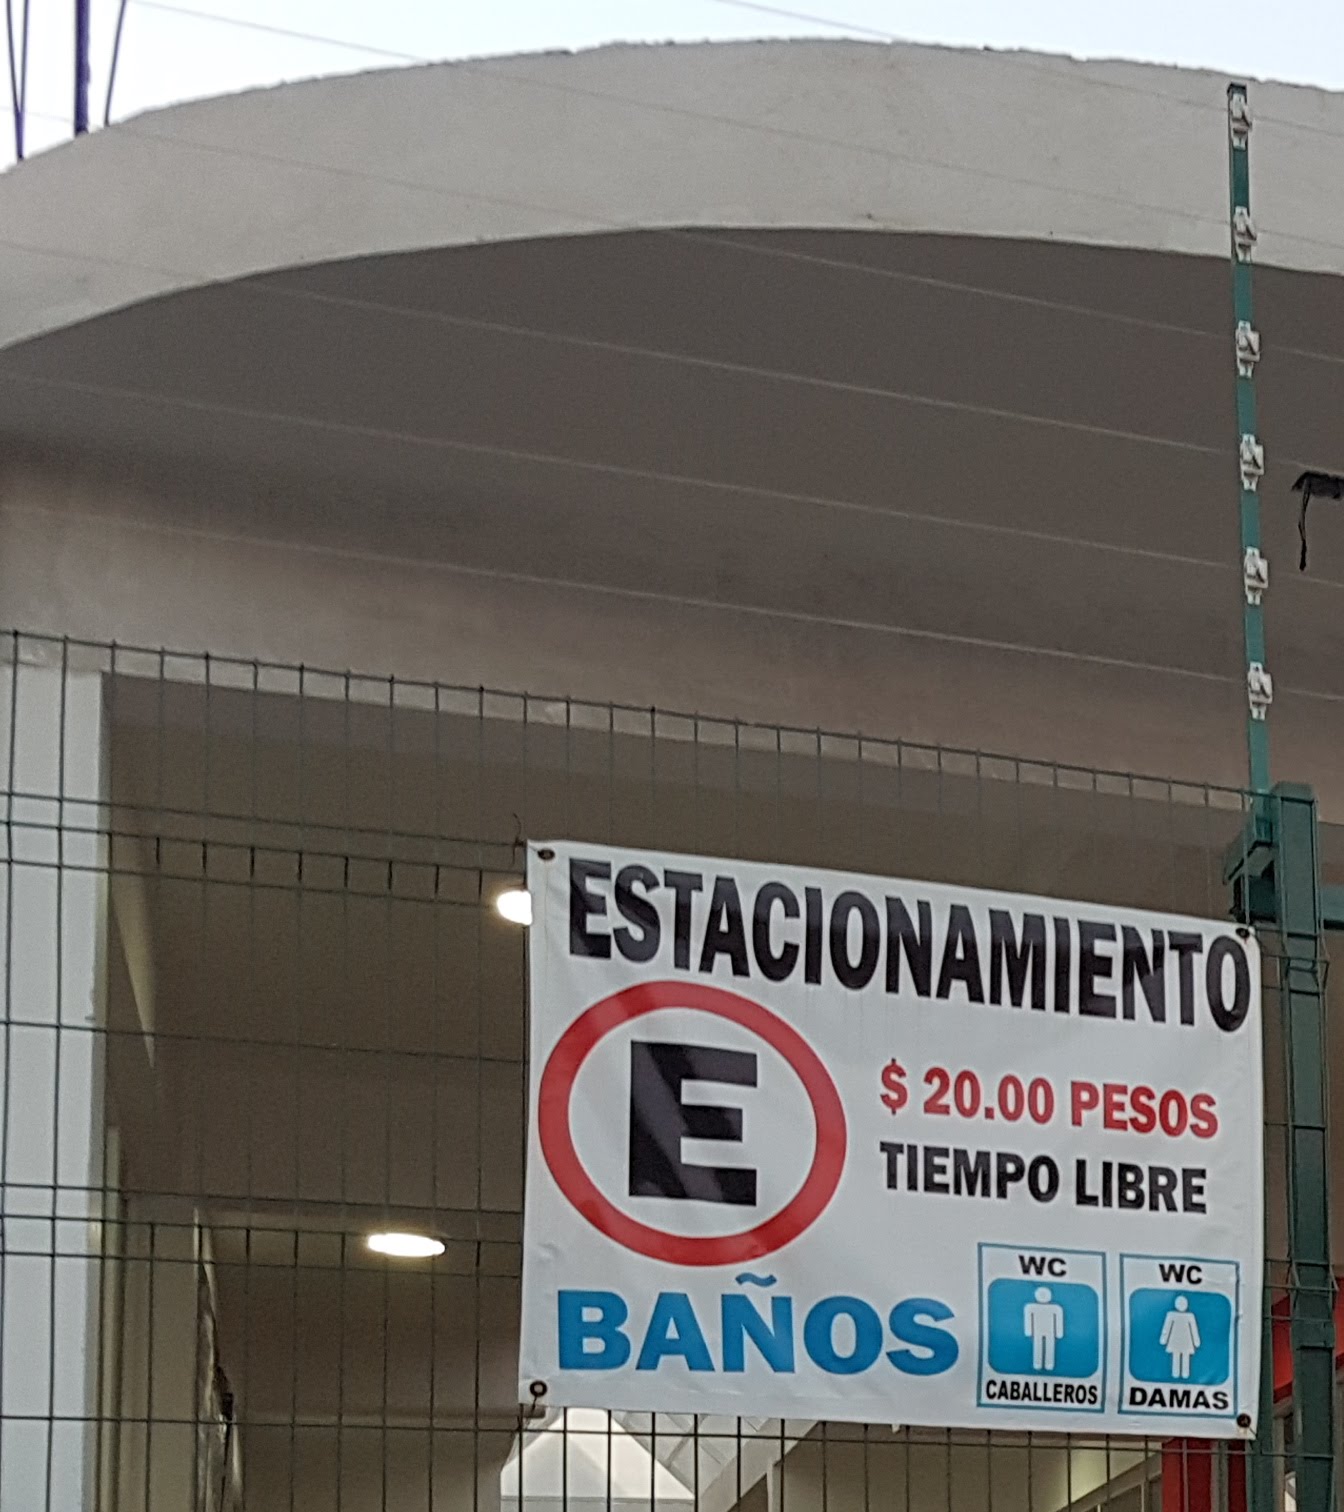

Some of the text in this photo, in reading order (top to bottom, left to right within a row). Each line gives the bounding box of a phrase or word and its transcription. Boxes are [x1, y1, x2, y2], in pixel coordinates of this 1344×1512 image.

[567, 857, 1252, 1034] ESTACIONAMIENTO
[629, 1039, 758, 1207] E
[923, 1066, 1055, 1126] 20.00
[1071, 1081, 1220, 1139] PESOS
[880, 1140, 1207, 1215] TIEMPO LIBRE
[1018, 1254, 1068, 1278] WC
[1158, 1262, 1204, 1286] WC
[557, 1272, 960, 1377] BAÑOS
[985, 1378, 1098, 1406] CABALLEROS
[1128, 1386, 1230, 1411] DAMAS
